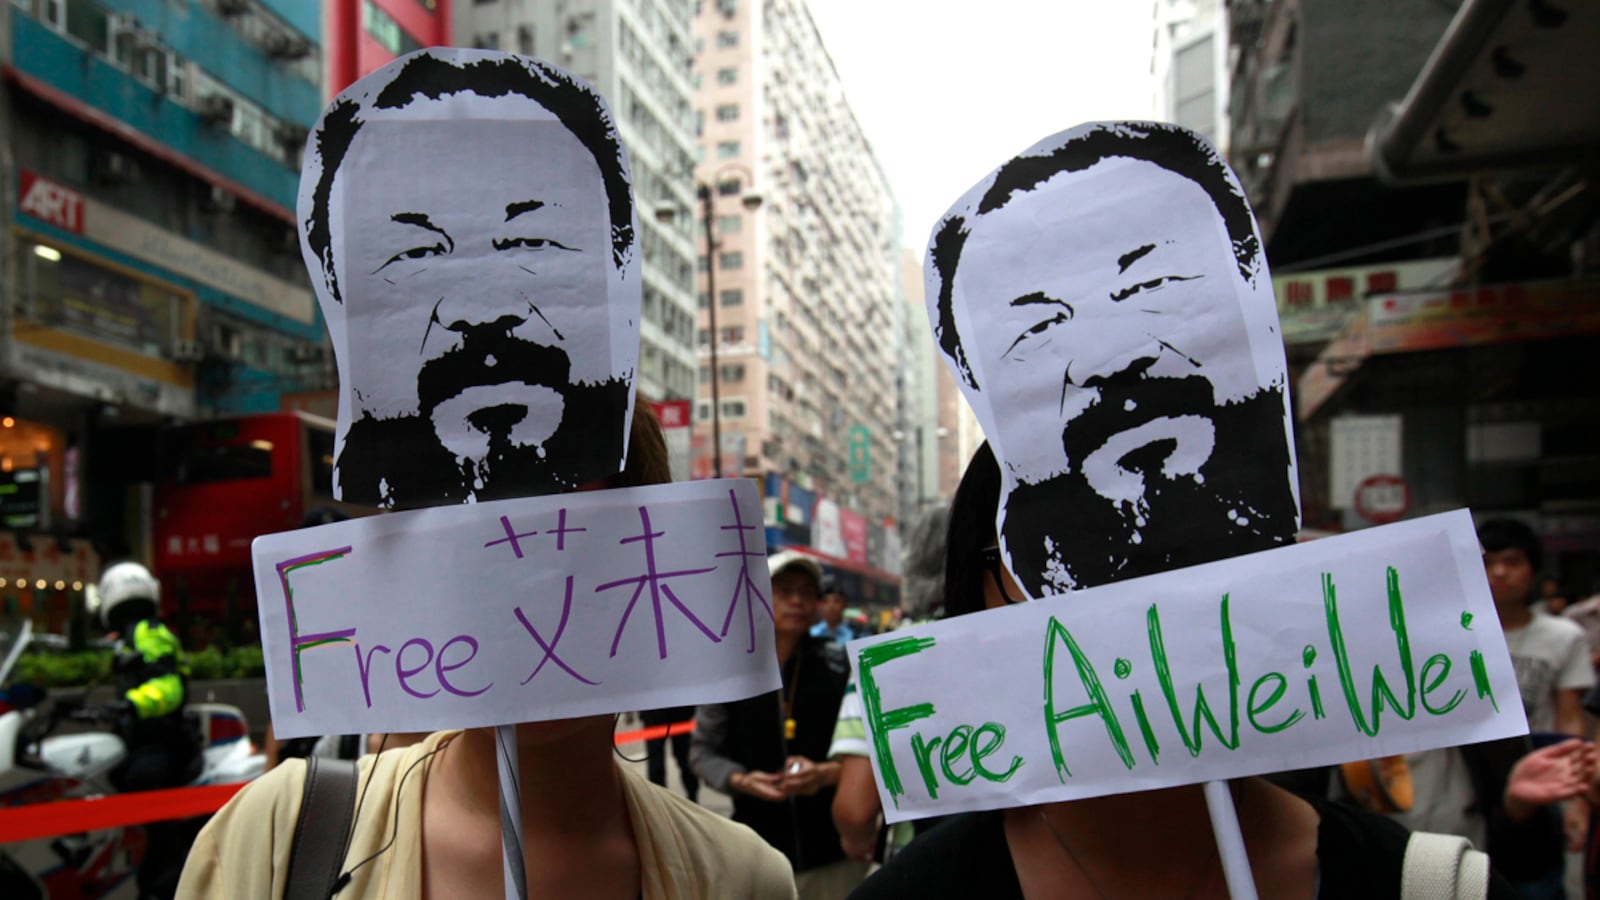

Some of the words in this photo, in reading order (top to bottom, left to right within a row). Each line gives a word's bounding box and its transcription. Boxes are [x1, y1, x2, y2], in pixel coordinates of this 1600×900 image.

[20, 176, 83, 230] ART
[276, 545, 495, 713] Free
[858, 636, 1027, 808] Free
[1043, 565, 1499, 783] AiWeiWei
